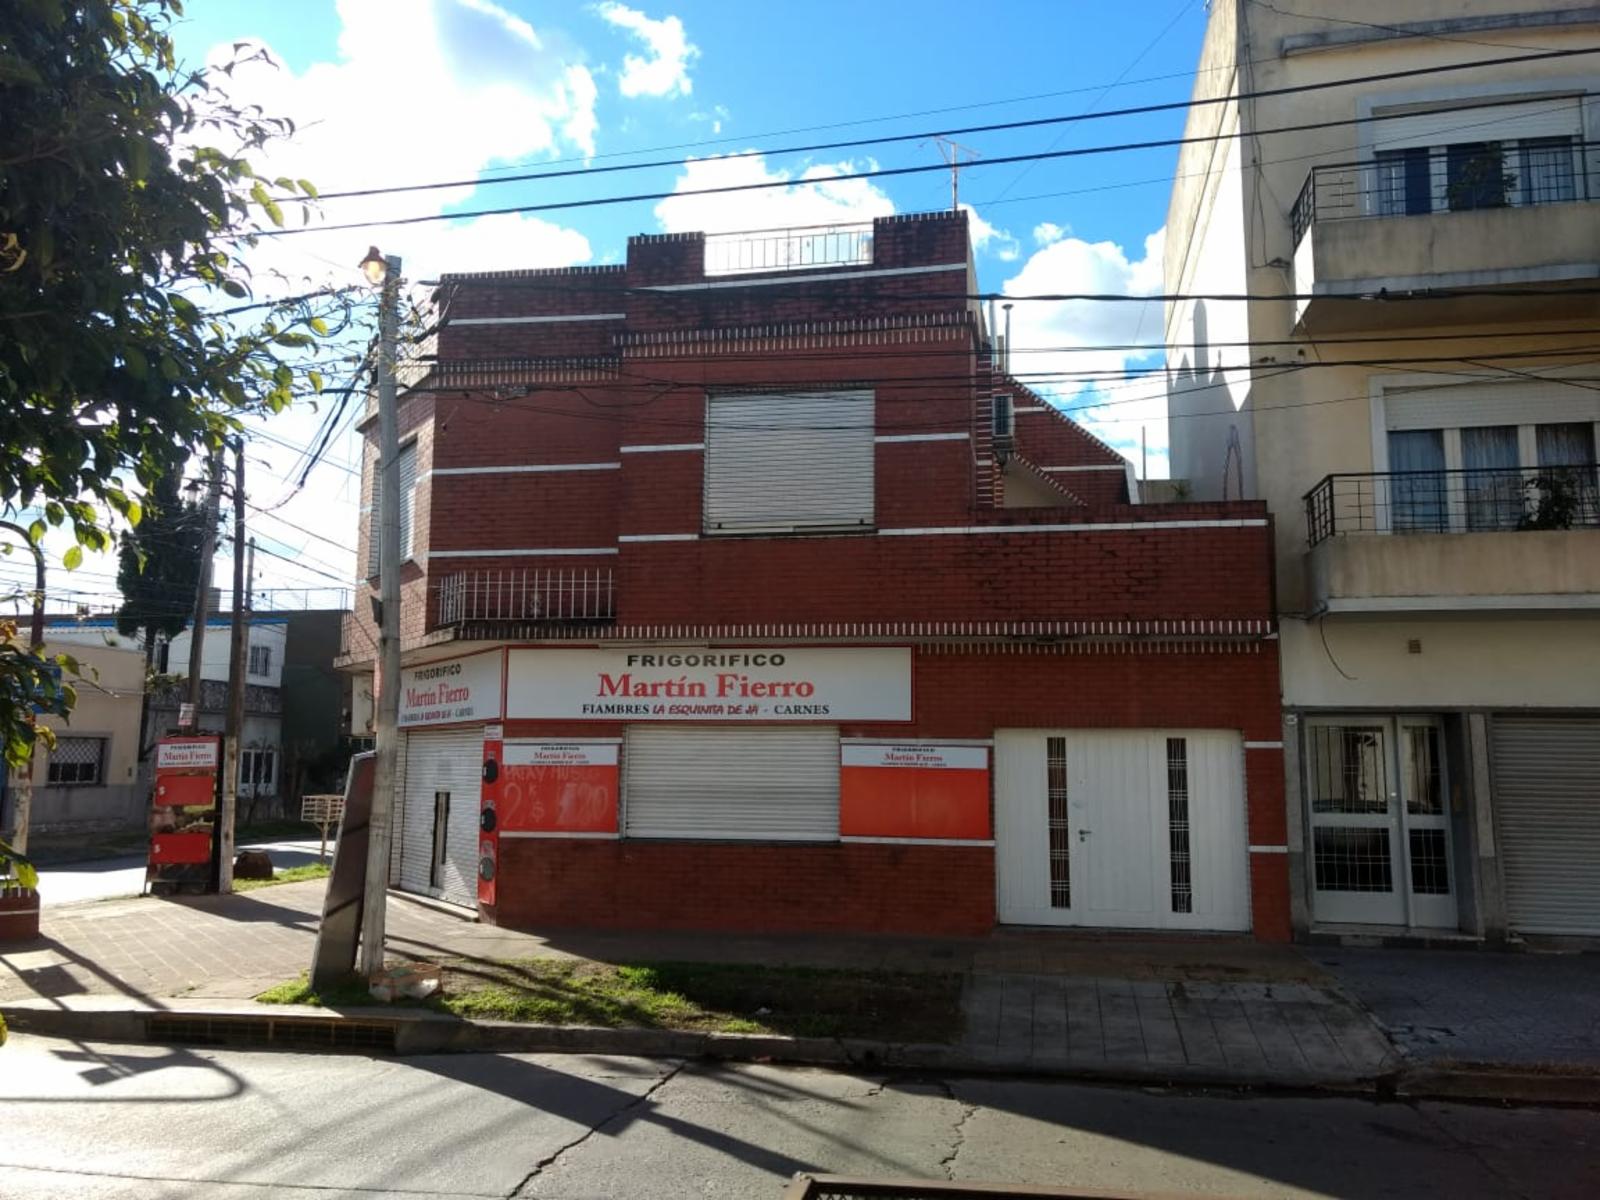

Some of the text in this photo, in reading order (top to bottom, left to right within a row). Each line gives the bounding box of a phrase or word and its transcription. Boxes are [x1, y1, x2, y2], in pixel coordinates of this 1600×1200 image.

[627, 653, 785, 667] FRIGORIFICO
[597, 673, 814, 698] Martín Fierro
[582, 704, 650, 715] FIAMBRES
[652, 704, 665, 715] LA
[727, 704, 742, 715] DE
[774, 704, 830, 715] CARNES
